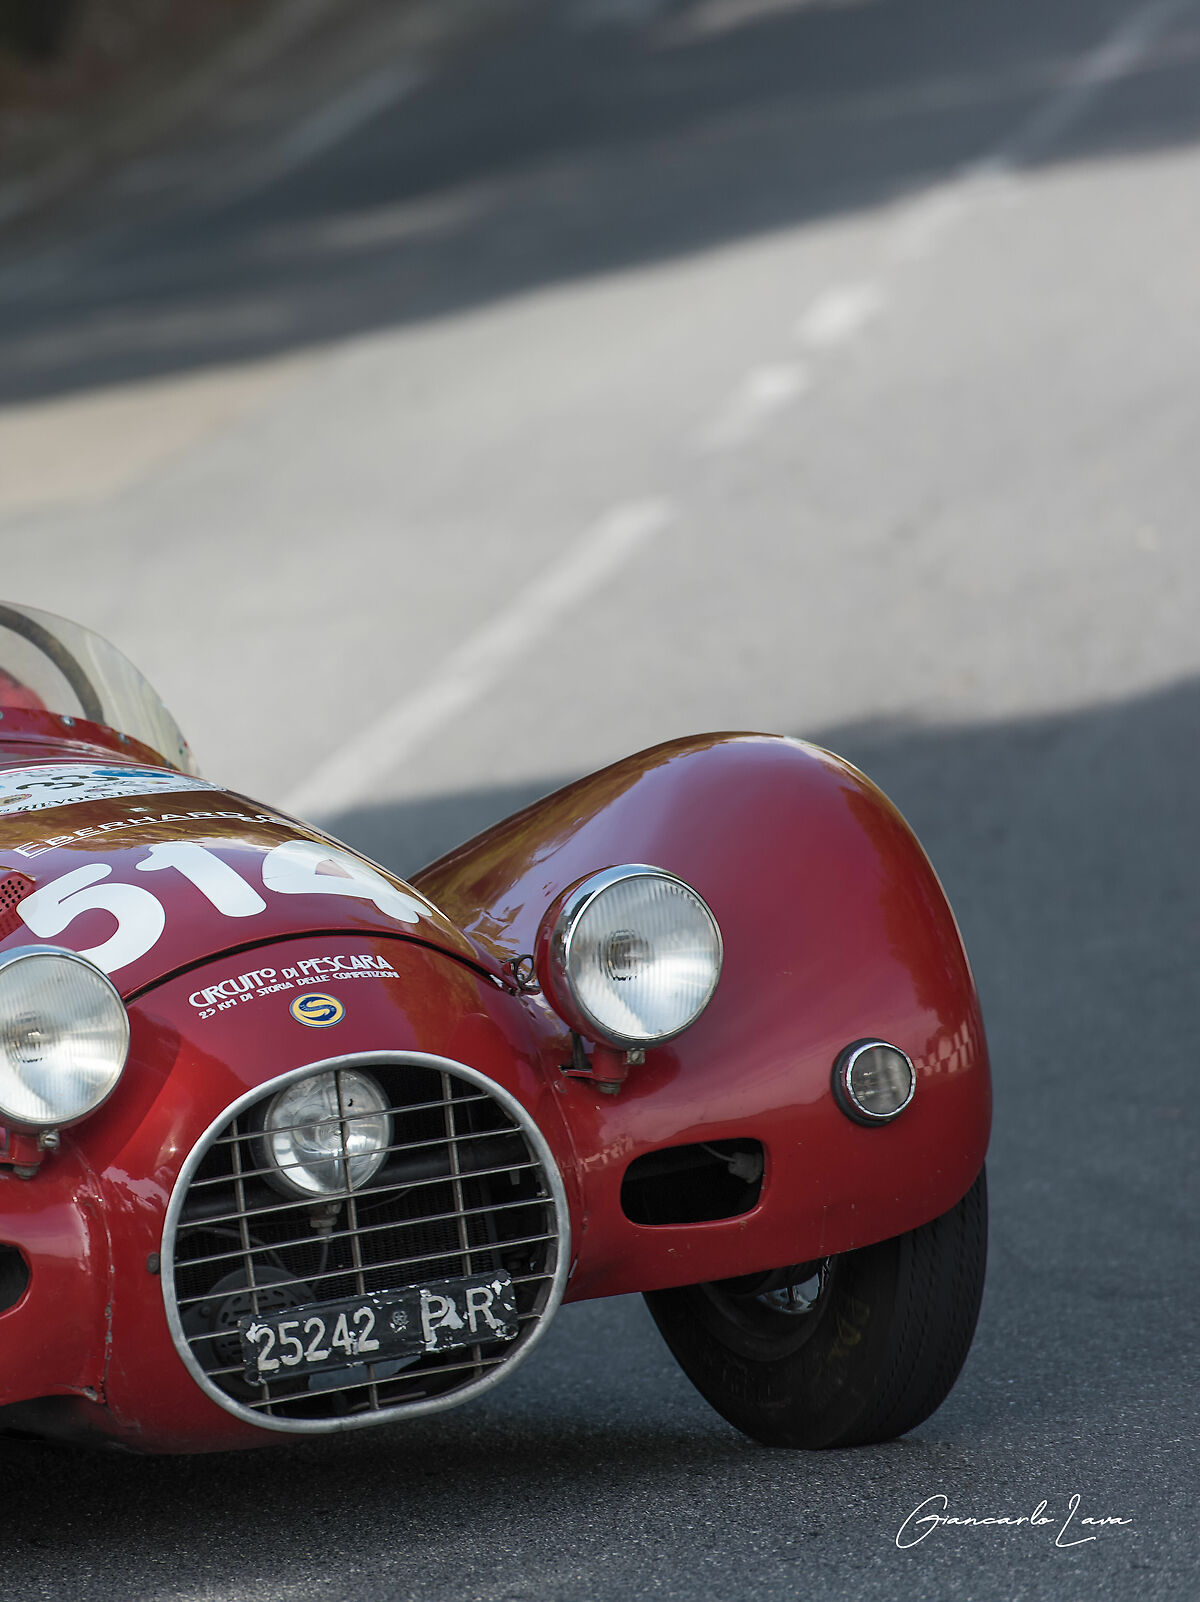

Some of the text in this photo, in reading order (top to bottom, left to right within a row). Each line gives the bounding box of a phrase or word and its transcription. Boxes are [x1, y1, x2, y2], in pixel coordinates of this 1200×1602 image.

[13, 810, 245, 856] EBERHARD
[16, 839, 433, 975] 514
[188, 954, 394, 1008] CIRCUITO DI PESCARA
[198, 1006, 216, 1020] 25
[217, 999, 237, 1011] KM
[239, 993, 254, 1001] DI
[256, 981, 295, 997] STORIA
[296, 974, 330, 987] DELLE
[254, 1307, 380, 1371] 25242
